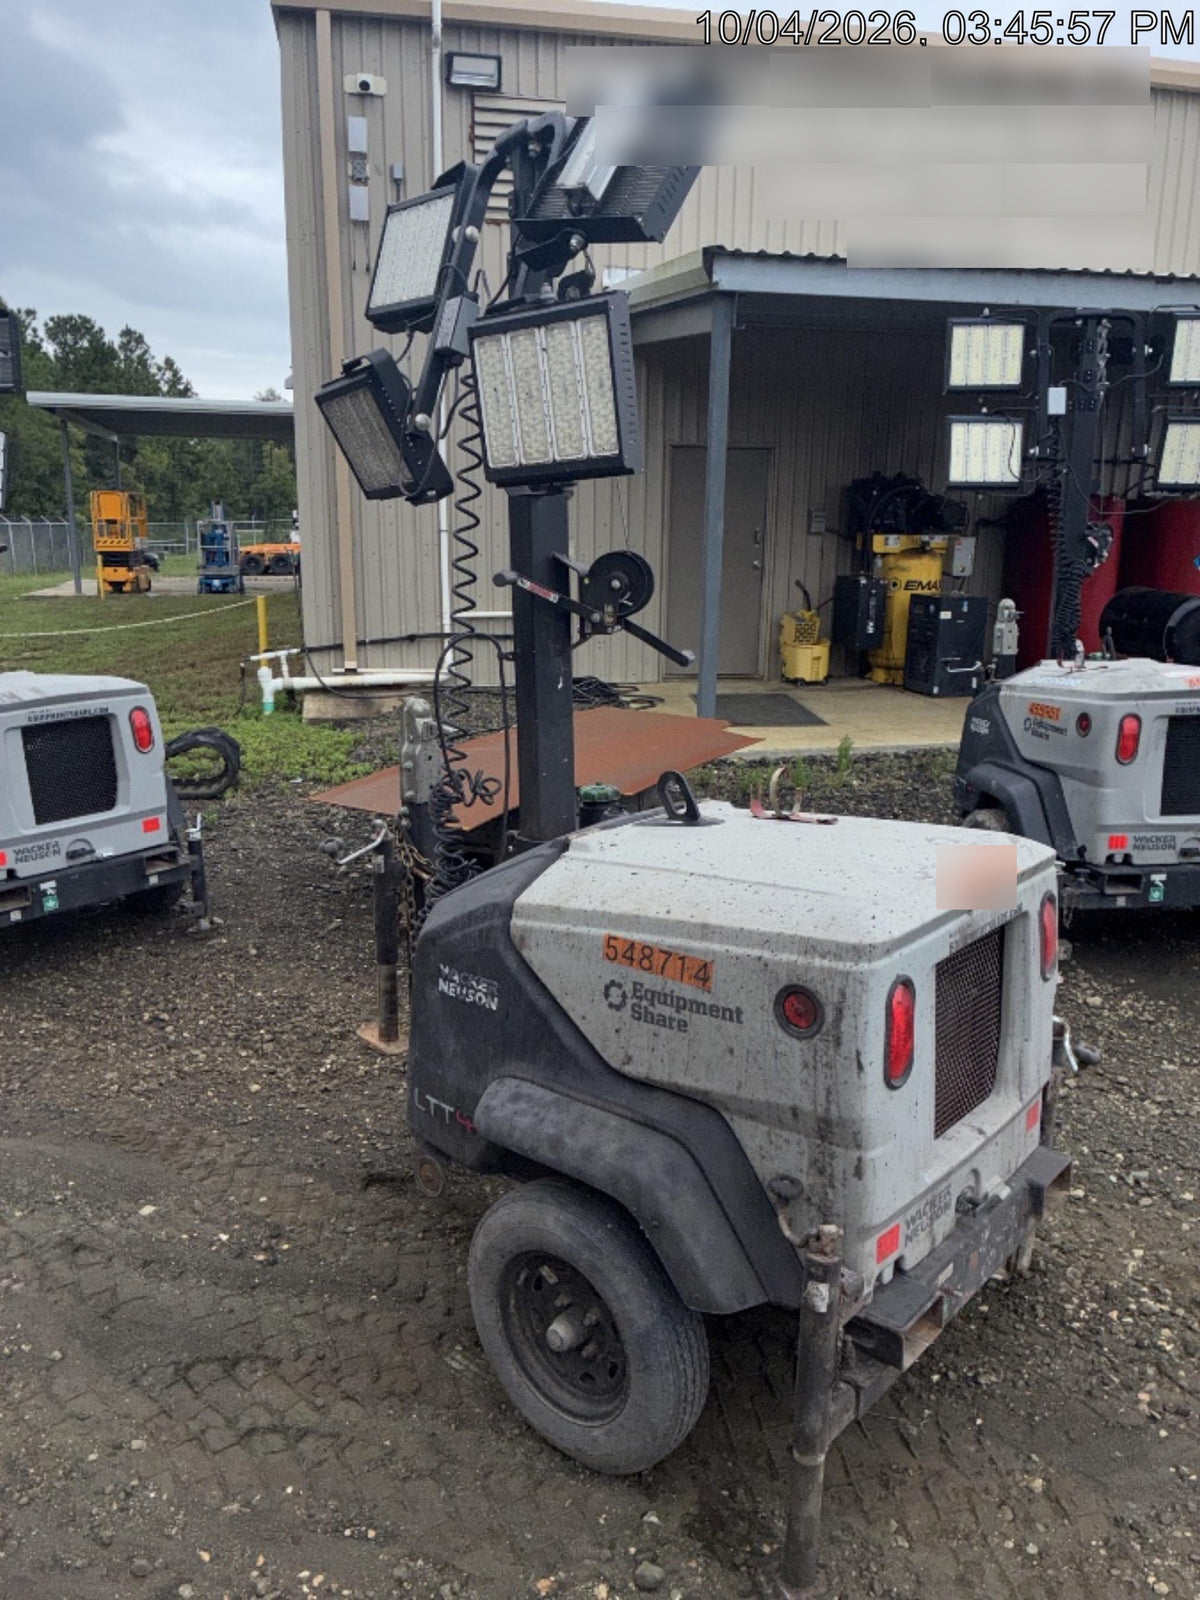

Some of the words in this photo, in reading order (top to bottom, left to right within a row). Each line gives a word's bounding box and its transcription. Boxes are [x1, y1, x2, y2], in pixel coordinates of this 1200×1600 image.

[1132, 842, 1176, 851] NEUSON
[1133, 834, 1176, 843] WACKER
[15, 848, 61, 865] NEUSON
[605, 935, 711, 988] 548714
[631, 981, 744, 1025] Equipment
[630, 1002, 689, 1033] Share
